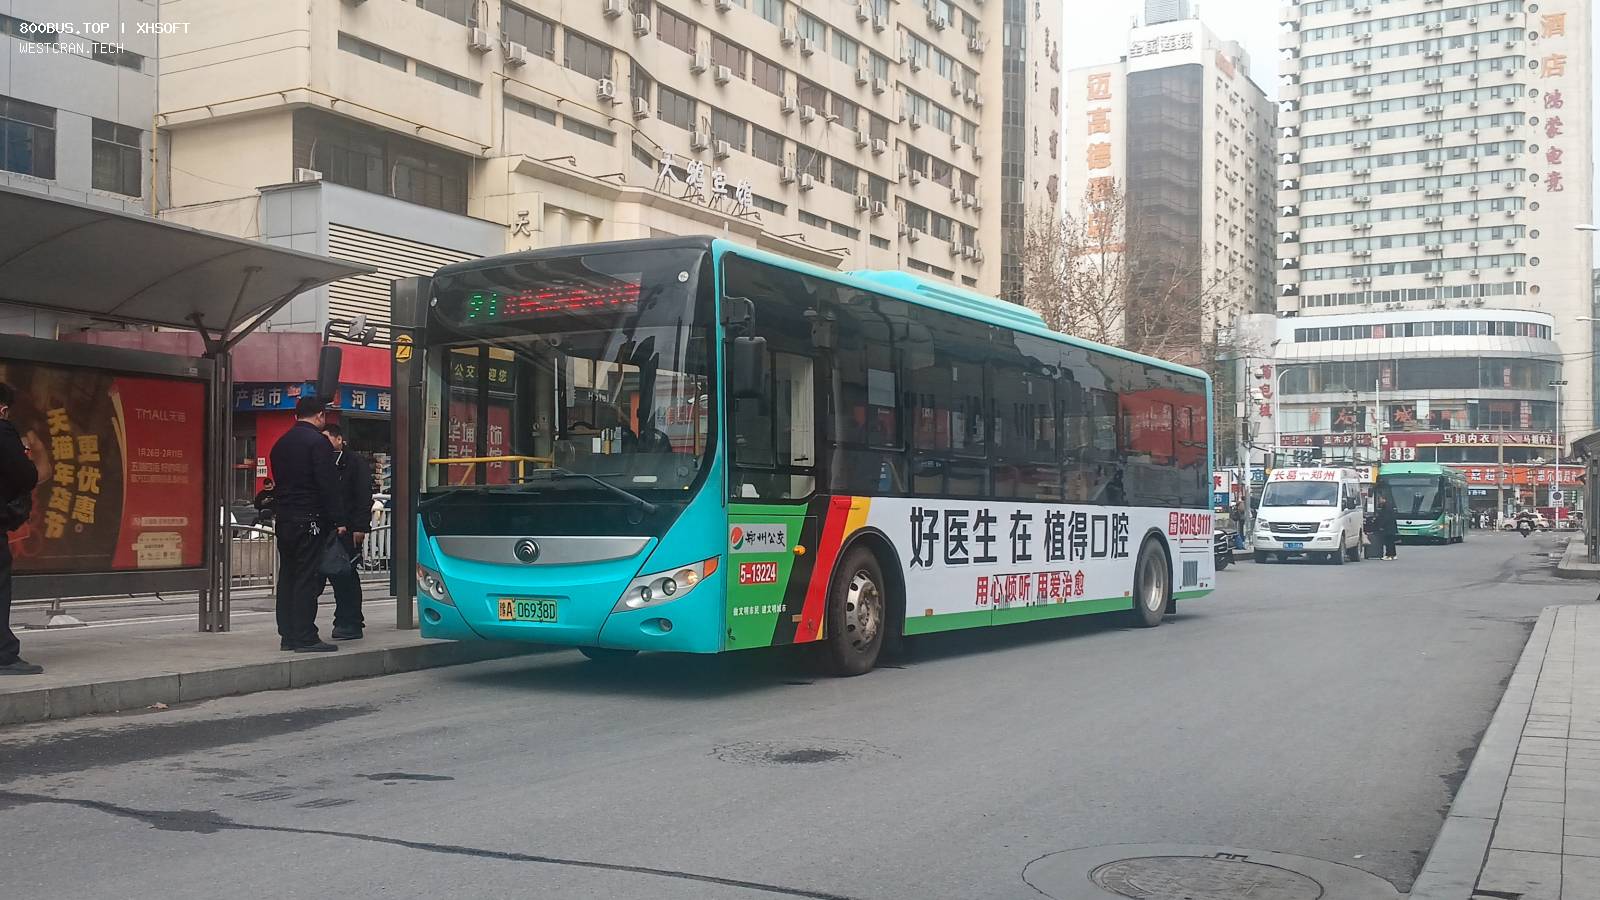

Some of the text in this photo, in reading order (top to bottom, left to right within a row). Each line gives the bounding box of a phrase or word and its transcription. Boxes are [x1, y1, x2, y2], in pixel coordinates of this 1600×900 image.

[1310, 470, 1336, 480] 郑州
[745, 531, 785, 548] 郑州公交
[910, 506, 1129, 568] 好医生 在 植得口腔
[740, 563, 776, 583] 5-13224
[976, 569, 1085, 606] 用心倾听 用爱治愈
